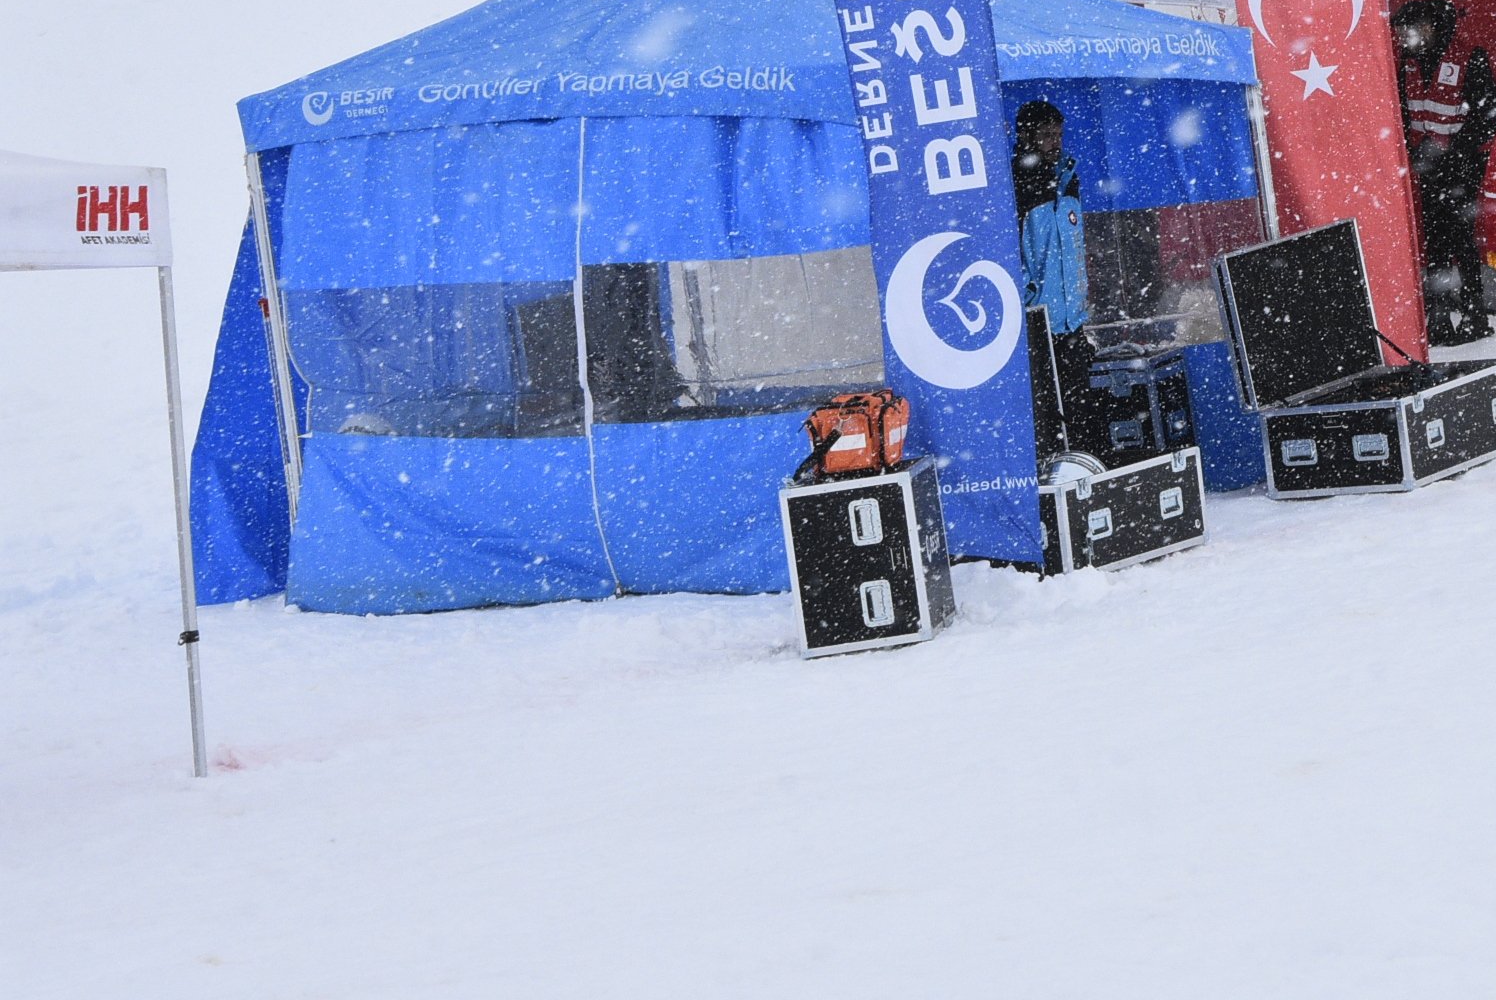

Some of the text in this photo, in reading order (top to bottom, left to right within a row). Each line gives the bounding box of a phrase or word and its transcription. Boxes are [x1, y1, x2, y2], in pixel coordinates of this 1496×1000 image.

[1166, 33, 1221, 56] Geldik
[557, 70, 691, 96] Yapmaya
[700, 65, 796, 91] Geldik
[81, 235, 103, 245] AFET
